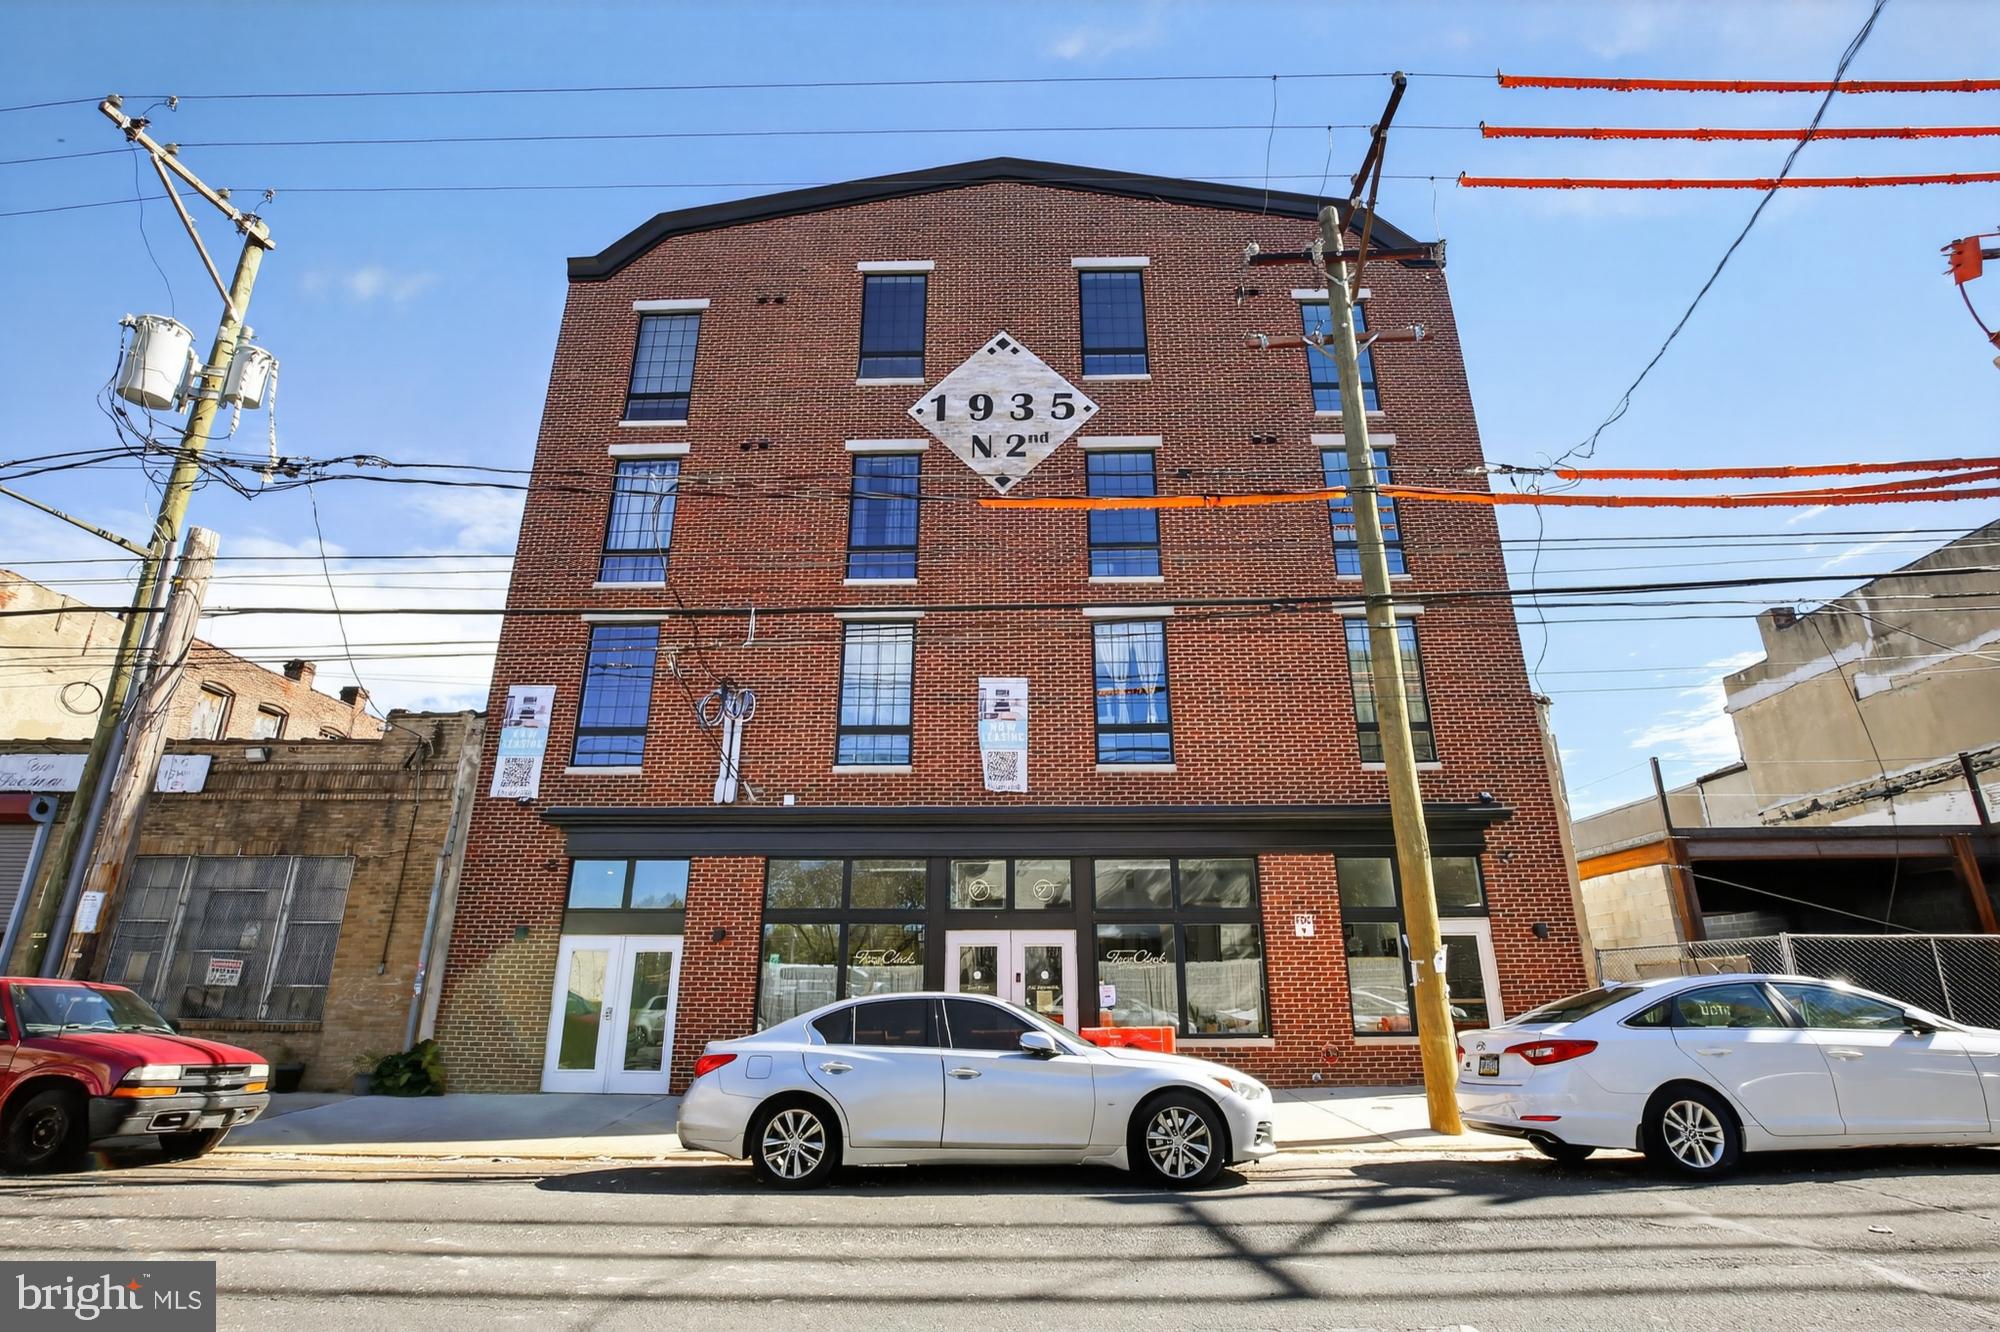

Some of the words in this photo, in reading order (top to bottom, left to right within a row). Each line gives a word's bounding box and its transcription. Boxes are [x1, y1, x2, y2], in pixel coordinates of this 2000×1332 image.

[931, 393, 1075, 421] 1935
[1006, 431, 1049, 457] 2nd
[982, 732, 1025, 741] LEASING
